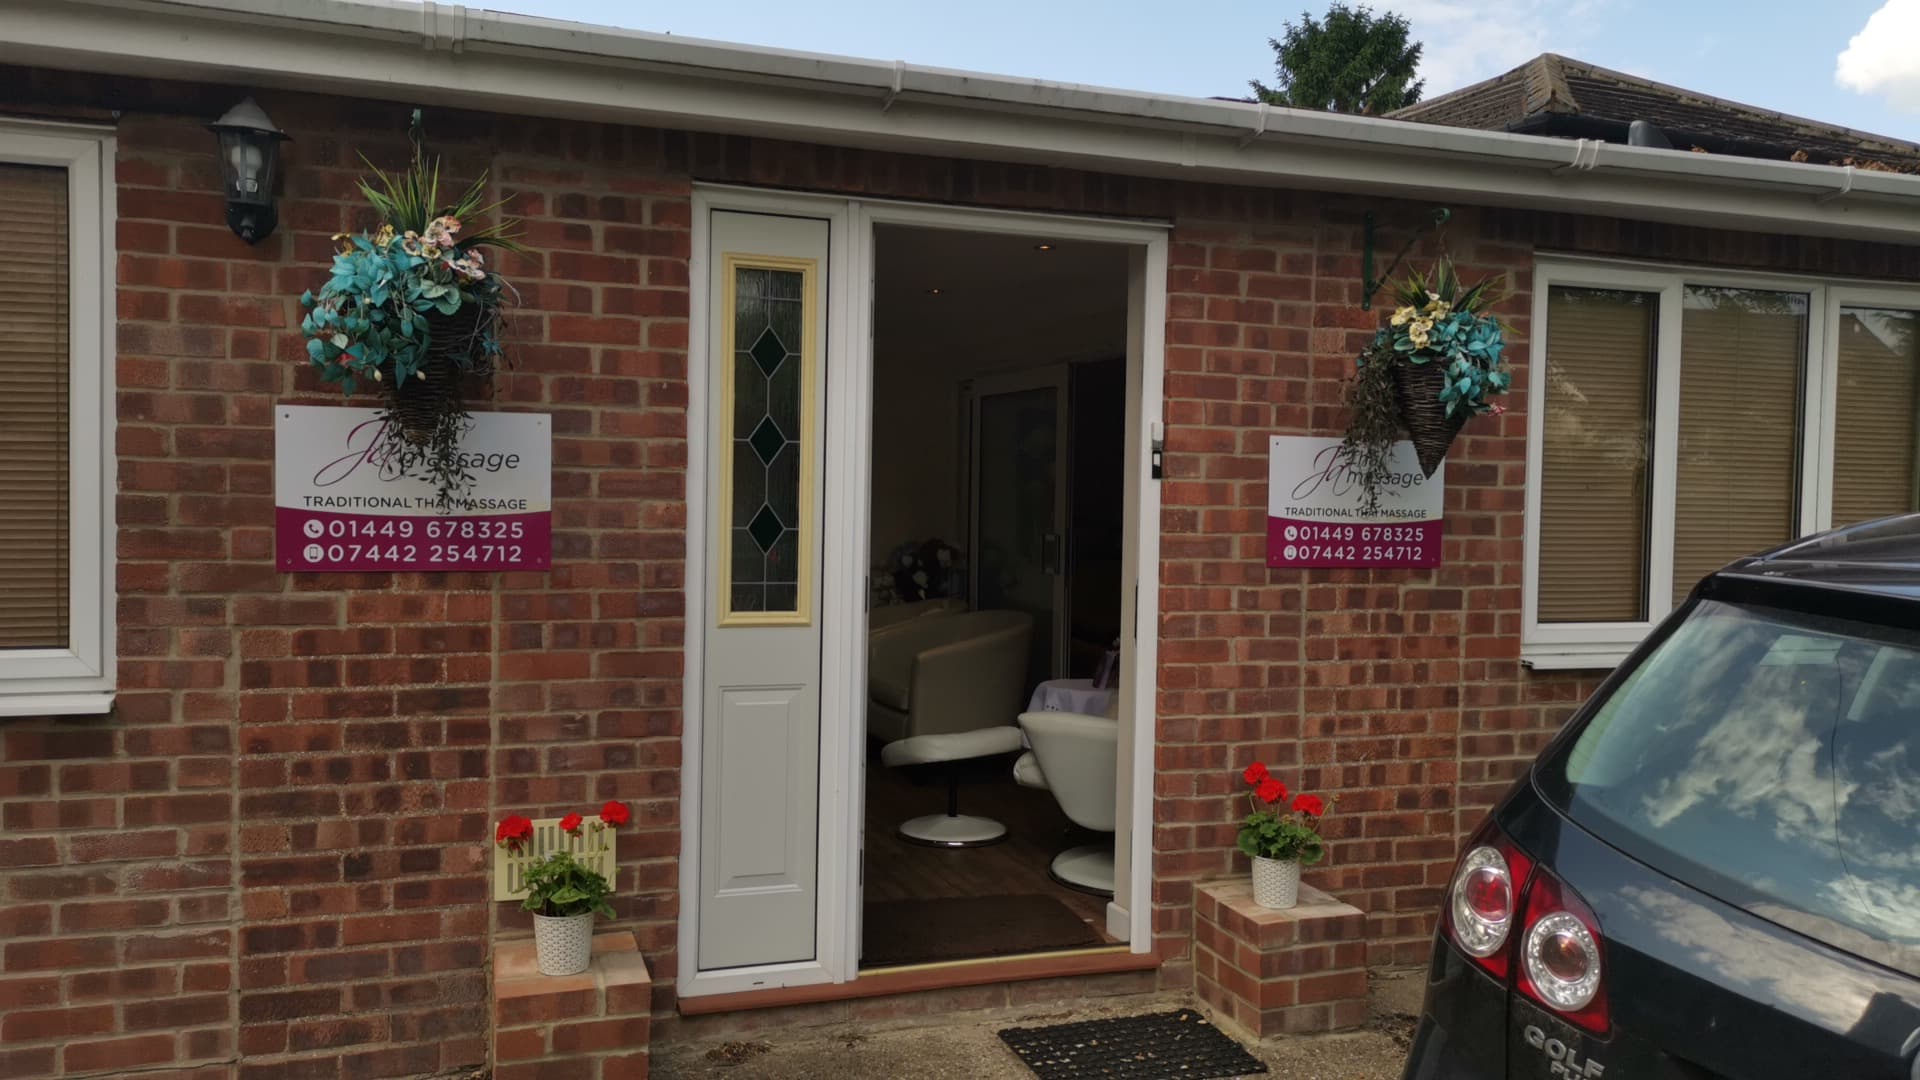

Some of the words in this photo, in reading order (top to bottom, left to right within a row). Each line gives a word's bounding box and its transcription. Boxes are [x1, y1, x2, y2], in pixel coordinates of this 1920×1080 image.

[303, 495, 412, 509] TRADITIONAL
[415, 497, 450, 510] THAI
[456, 498, 527, 511] MASSAGE
[1285, 507, 1353, 518] TRADITIONAL
[1381, 508, 1427, 519] MASSAGE
[328, 519, 414, 538] 01449
[426, 520, 524, 539] 678325
[1300, 526, 1354, 541] 01449
[1361, 527, 1424, 542] 678325
[327, 544, 417, 563] 07442
[429, 545, 522, 563] 254712
[1299, 546, 1355, 560] 07442
[1363, 546, 1422, 561] 254712
[1523, 1024, 1606, 1079] GOLF
